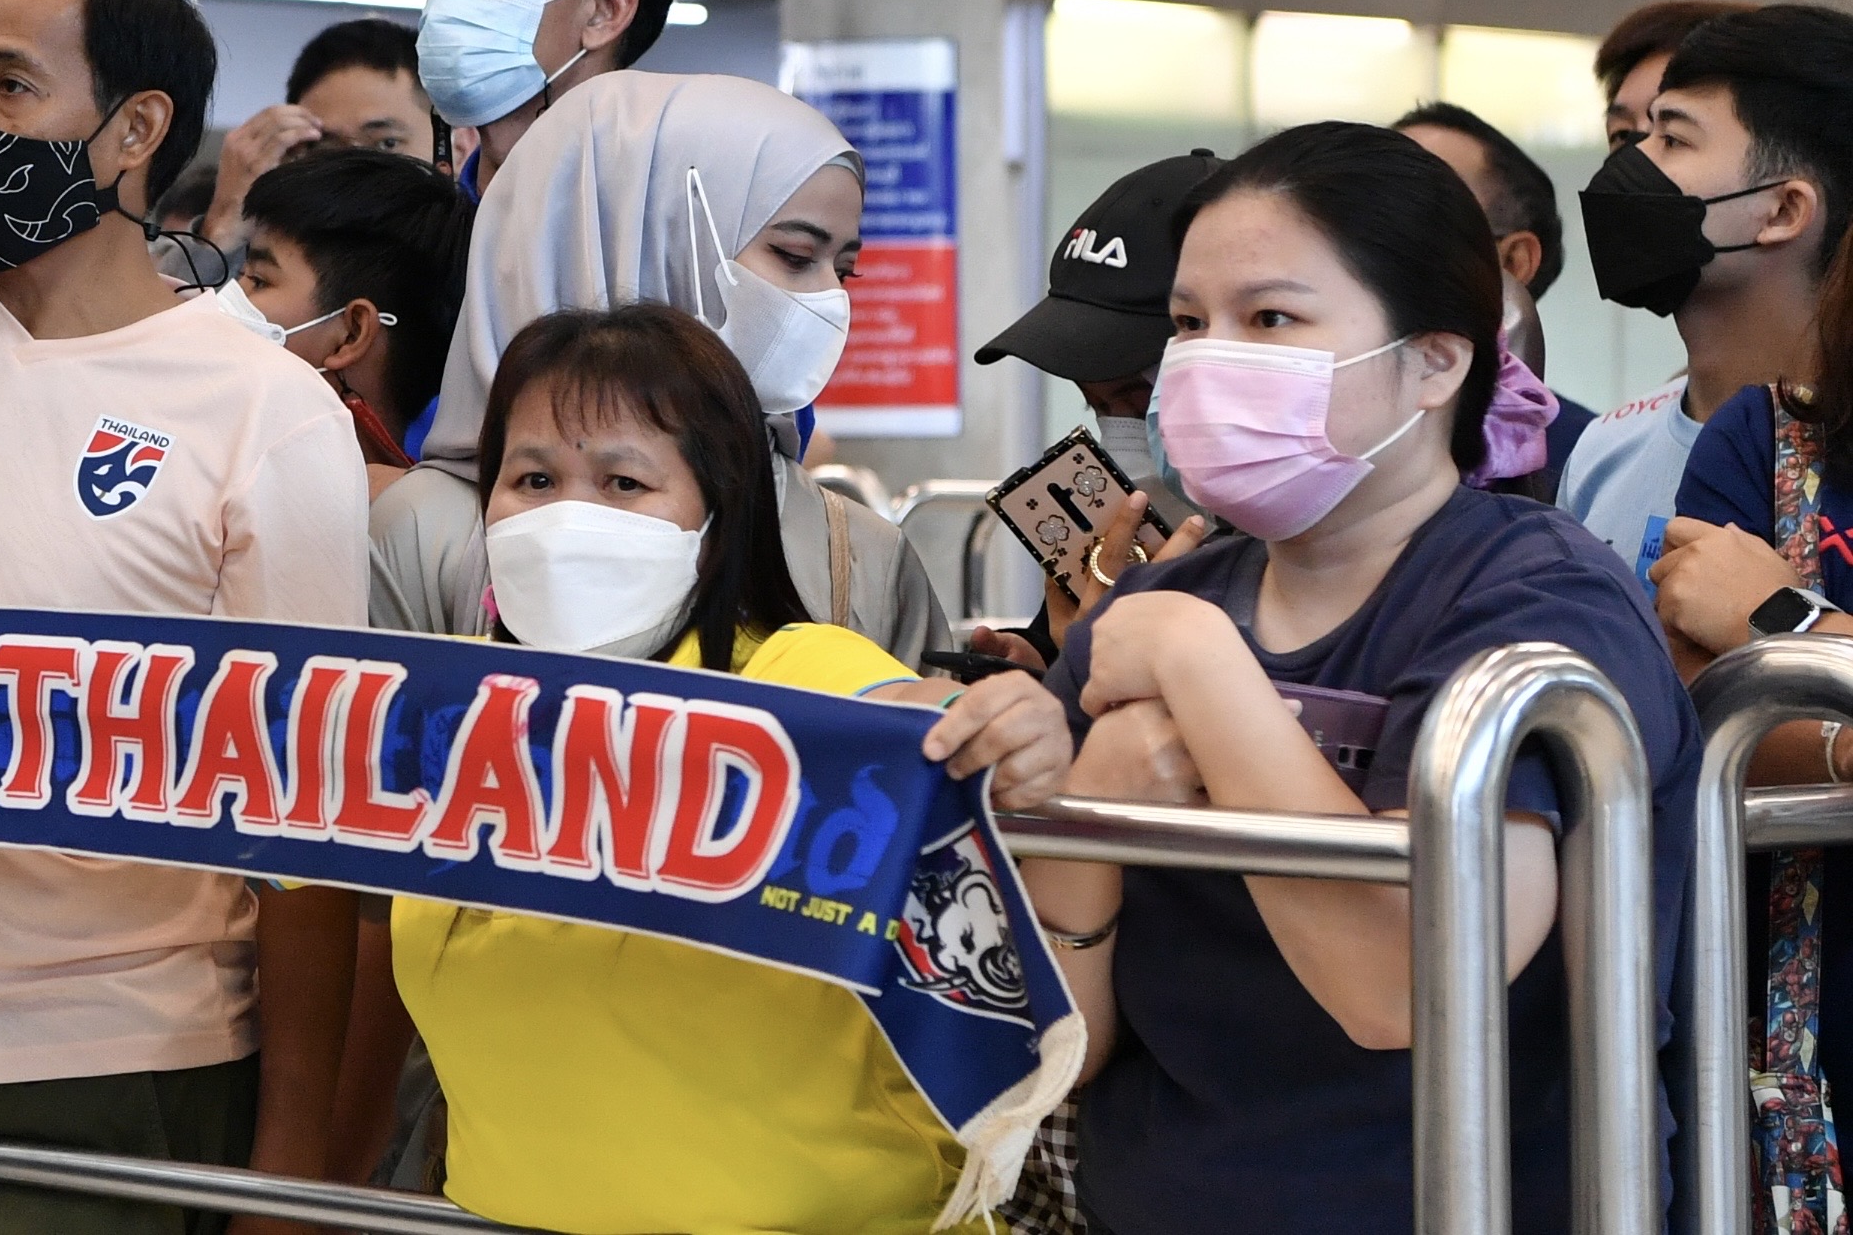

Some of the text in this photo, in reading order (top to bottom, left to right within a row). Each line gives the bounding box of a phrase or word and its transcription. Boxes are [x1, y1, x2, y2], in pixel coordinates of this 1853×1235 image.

[1064, 228, 1128, 268] FILA
[101, 418, 170, 448] THAILAND
[760, 884, 803, 913] NOT
[800, 896, 855, 926] JUST
[856, 911, 878, 936] A
